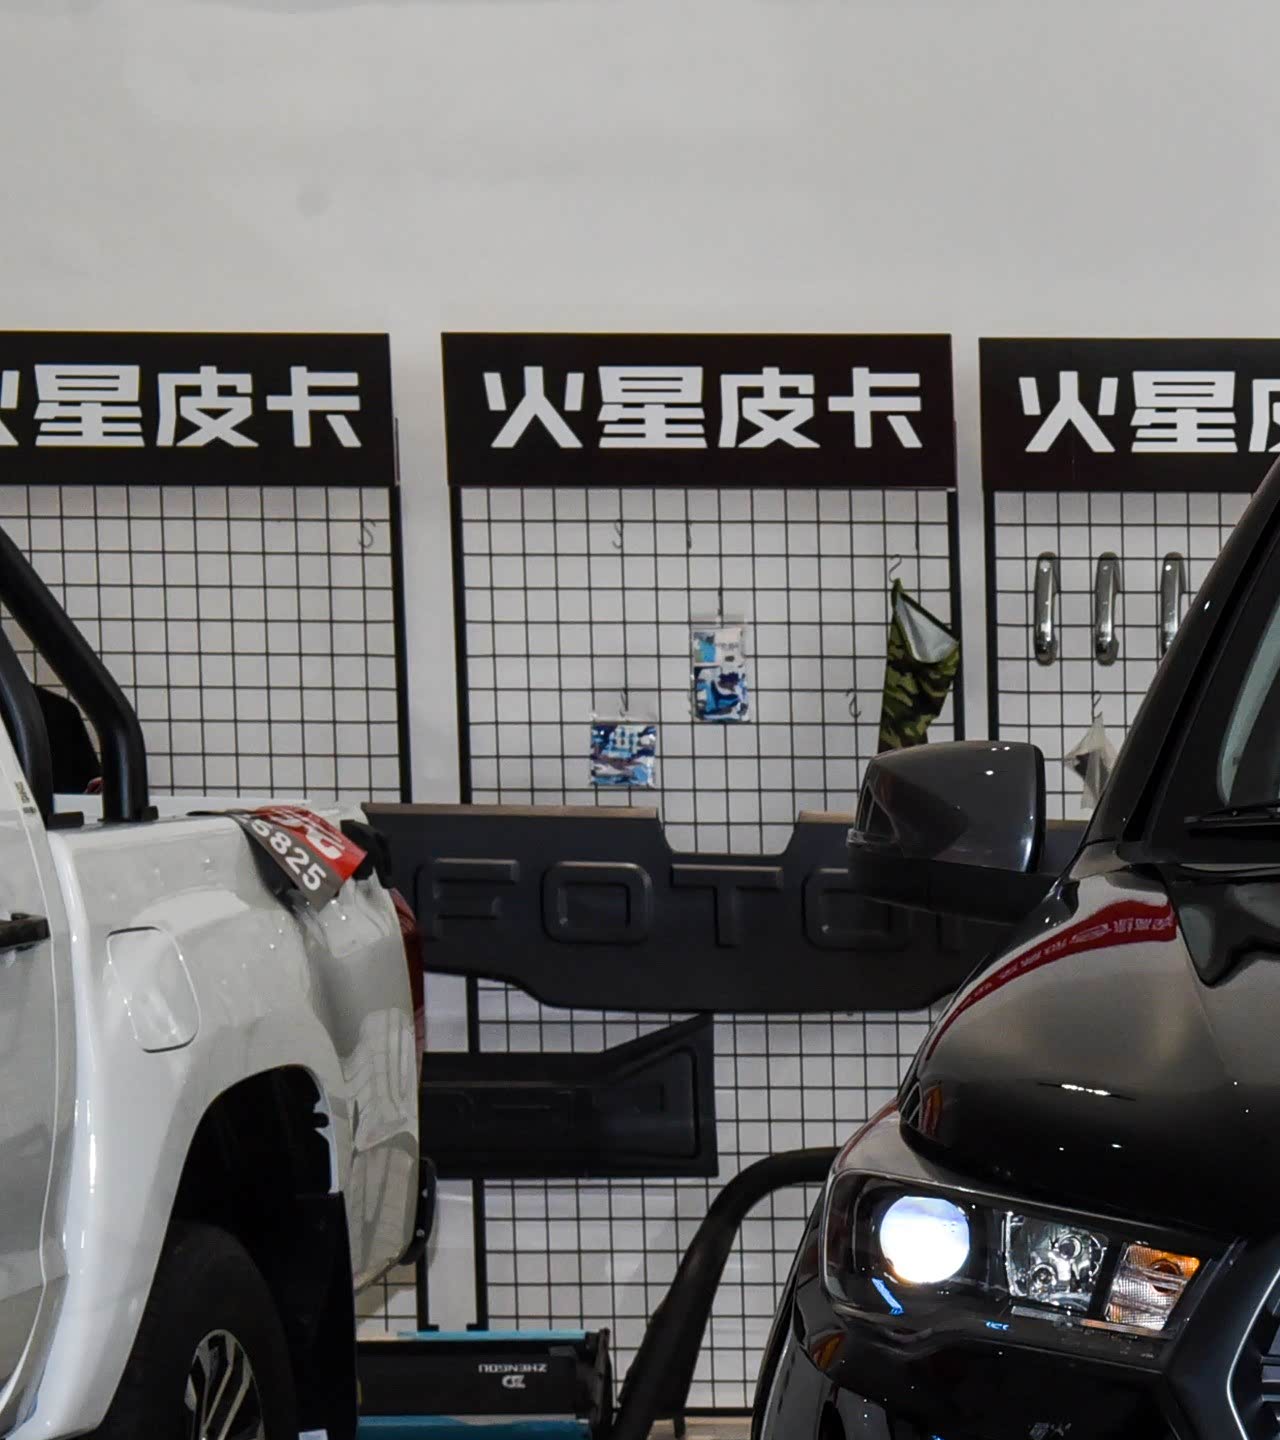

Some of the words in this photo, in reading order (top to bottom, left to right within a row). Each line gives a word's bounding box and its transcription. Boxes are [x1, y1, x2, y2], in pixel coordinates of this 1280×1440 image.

[0, 364, 362, 448] 星皮卡
[483, 365, 923, 450] 火星皮卡
